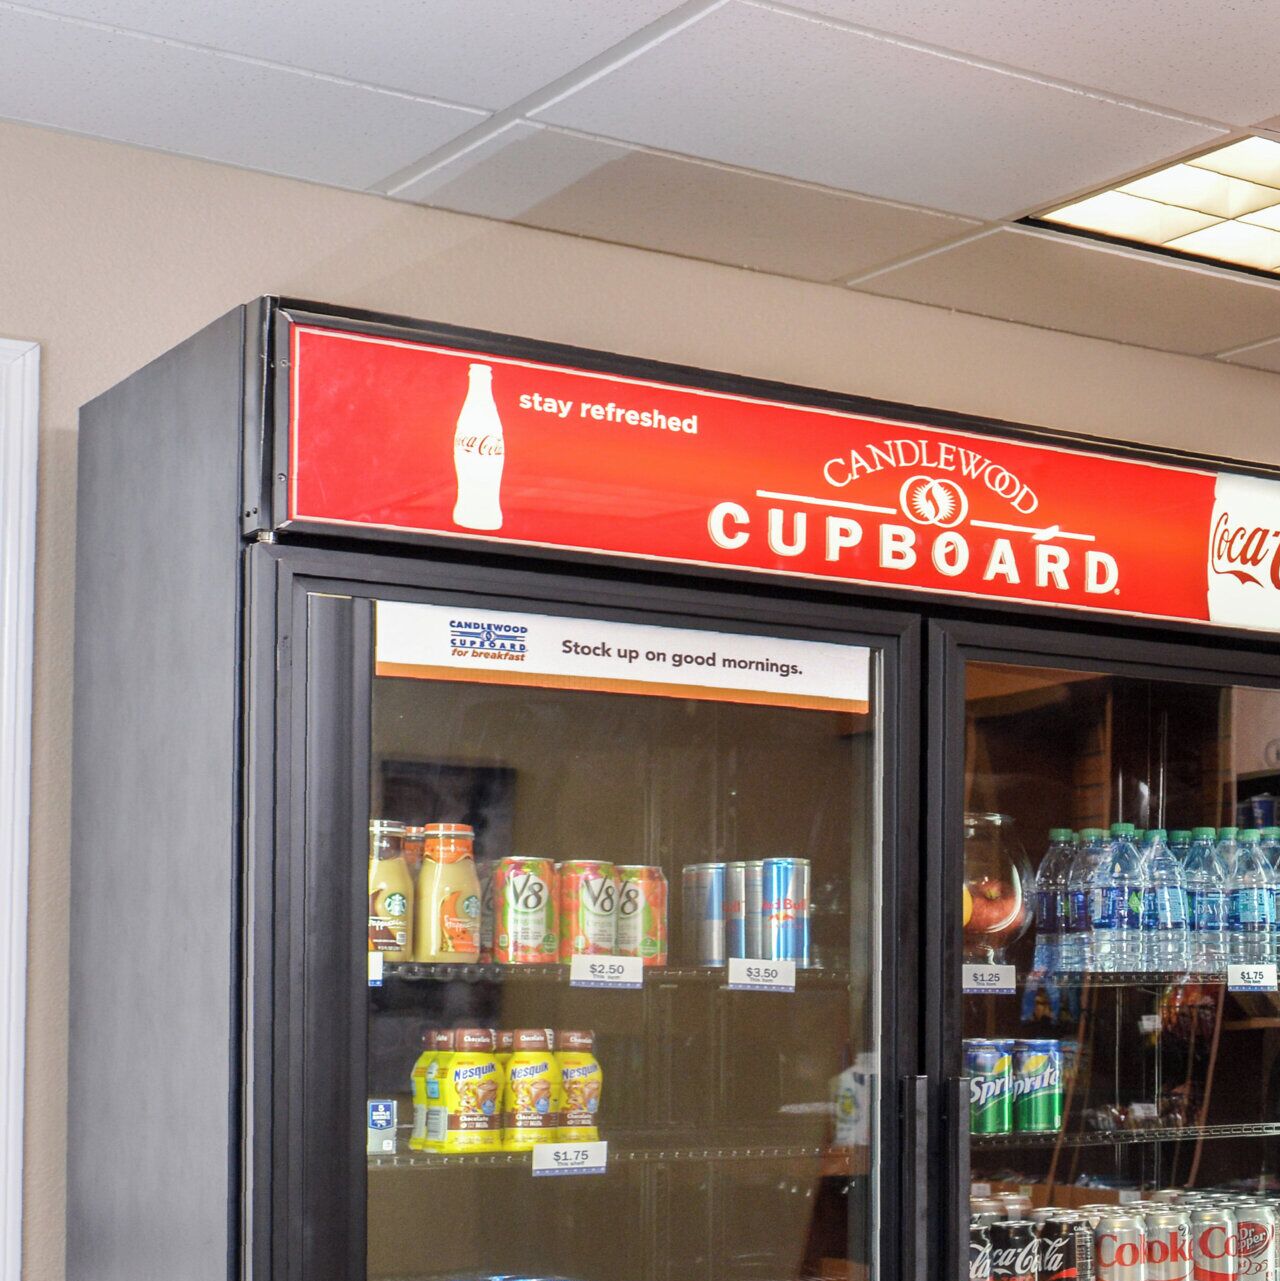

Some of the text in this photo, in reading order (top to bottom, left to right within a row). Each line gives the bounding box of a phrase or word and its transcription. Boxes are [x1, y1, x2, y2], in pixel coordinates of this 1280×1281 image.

[519, 391, 698, 434] stay refreshed
[823, 439, 1039, 515] CANDLEWOOD
[707, 502, 1119, 595] CUPBOARD
[449, 620, 528, 634] CANDLEWOOD
[450, 638, 527, 652] CUPBOARD
[451, 648, 526, 662] for breakfast
[561, 640, 803, 676] Stock up on good mornings.
[506, 871, 545, 909] V8
[583, 875, 615, 913] V8
[589, 963, 625, 976] $2.50
[746, 967, 778, 979] $3.50
[972, 972, 1001, 983] $1.25
[1239, 970, 1265, 981] $1.75
[453, 1062, 497, 1082] Nesquik
[509, 1062, 549, 1081] Nesquik
[561, 1062, 600, 1081] Nesquik
[552, 1150, 589, 1162] $1.75
[1239, 1225, 1256, 1240] Dr
